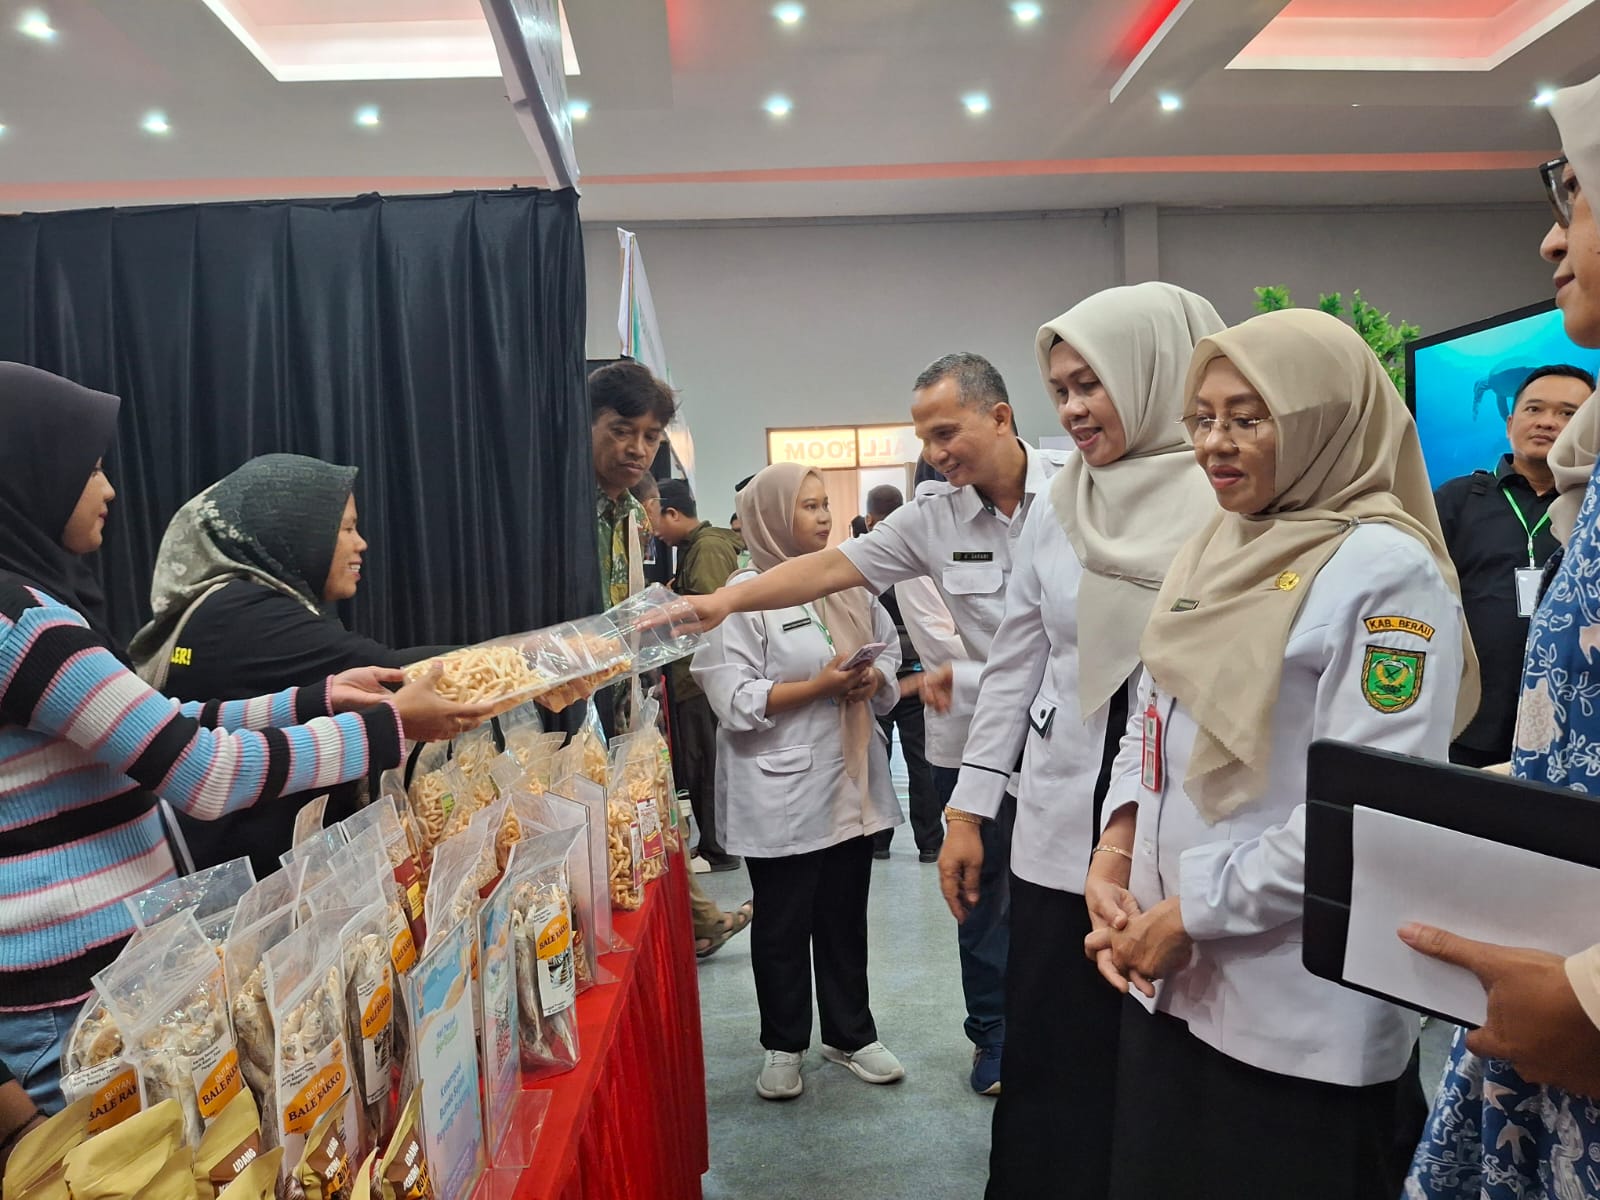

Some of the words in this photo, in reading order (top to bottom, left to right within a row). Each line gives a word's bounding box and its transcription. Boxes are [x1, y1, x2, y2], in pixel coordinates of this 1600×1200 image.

[1369, 619, 1394, 629] KAB.
[1398, 620, 1430, 636] BERAU
[202, 1082, 227, 1106] BALE
[288, 1099, 318, 1122] BALE
[232, 1147, 257, 1174] UDANG
